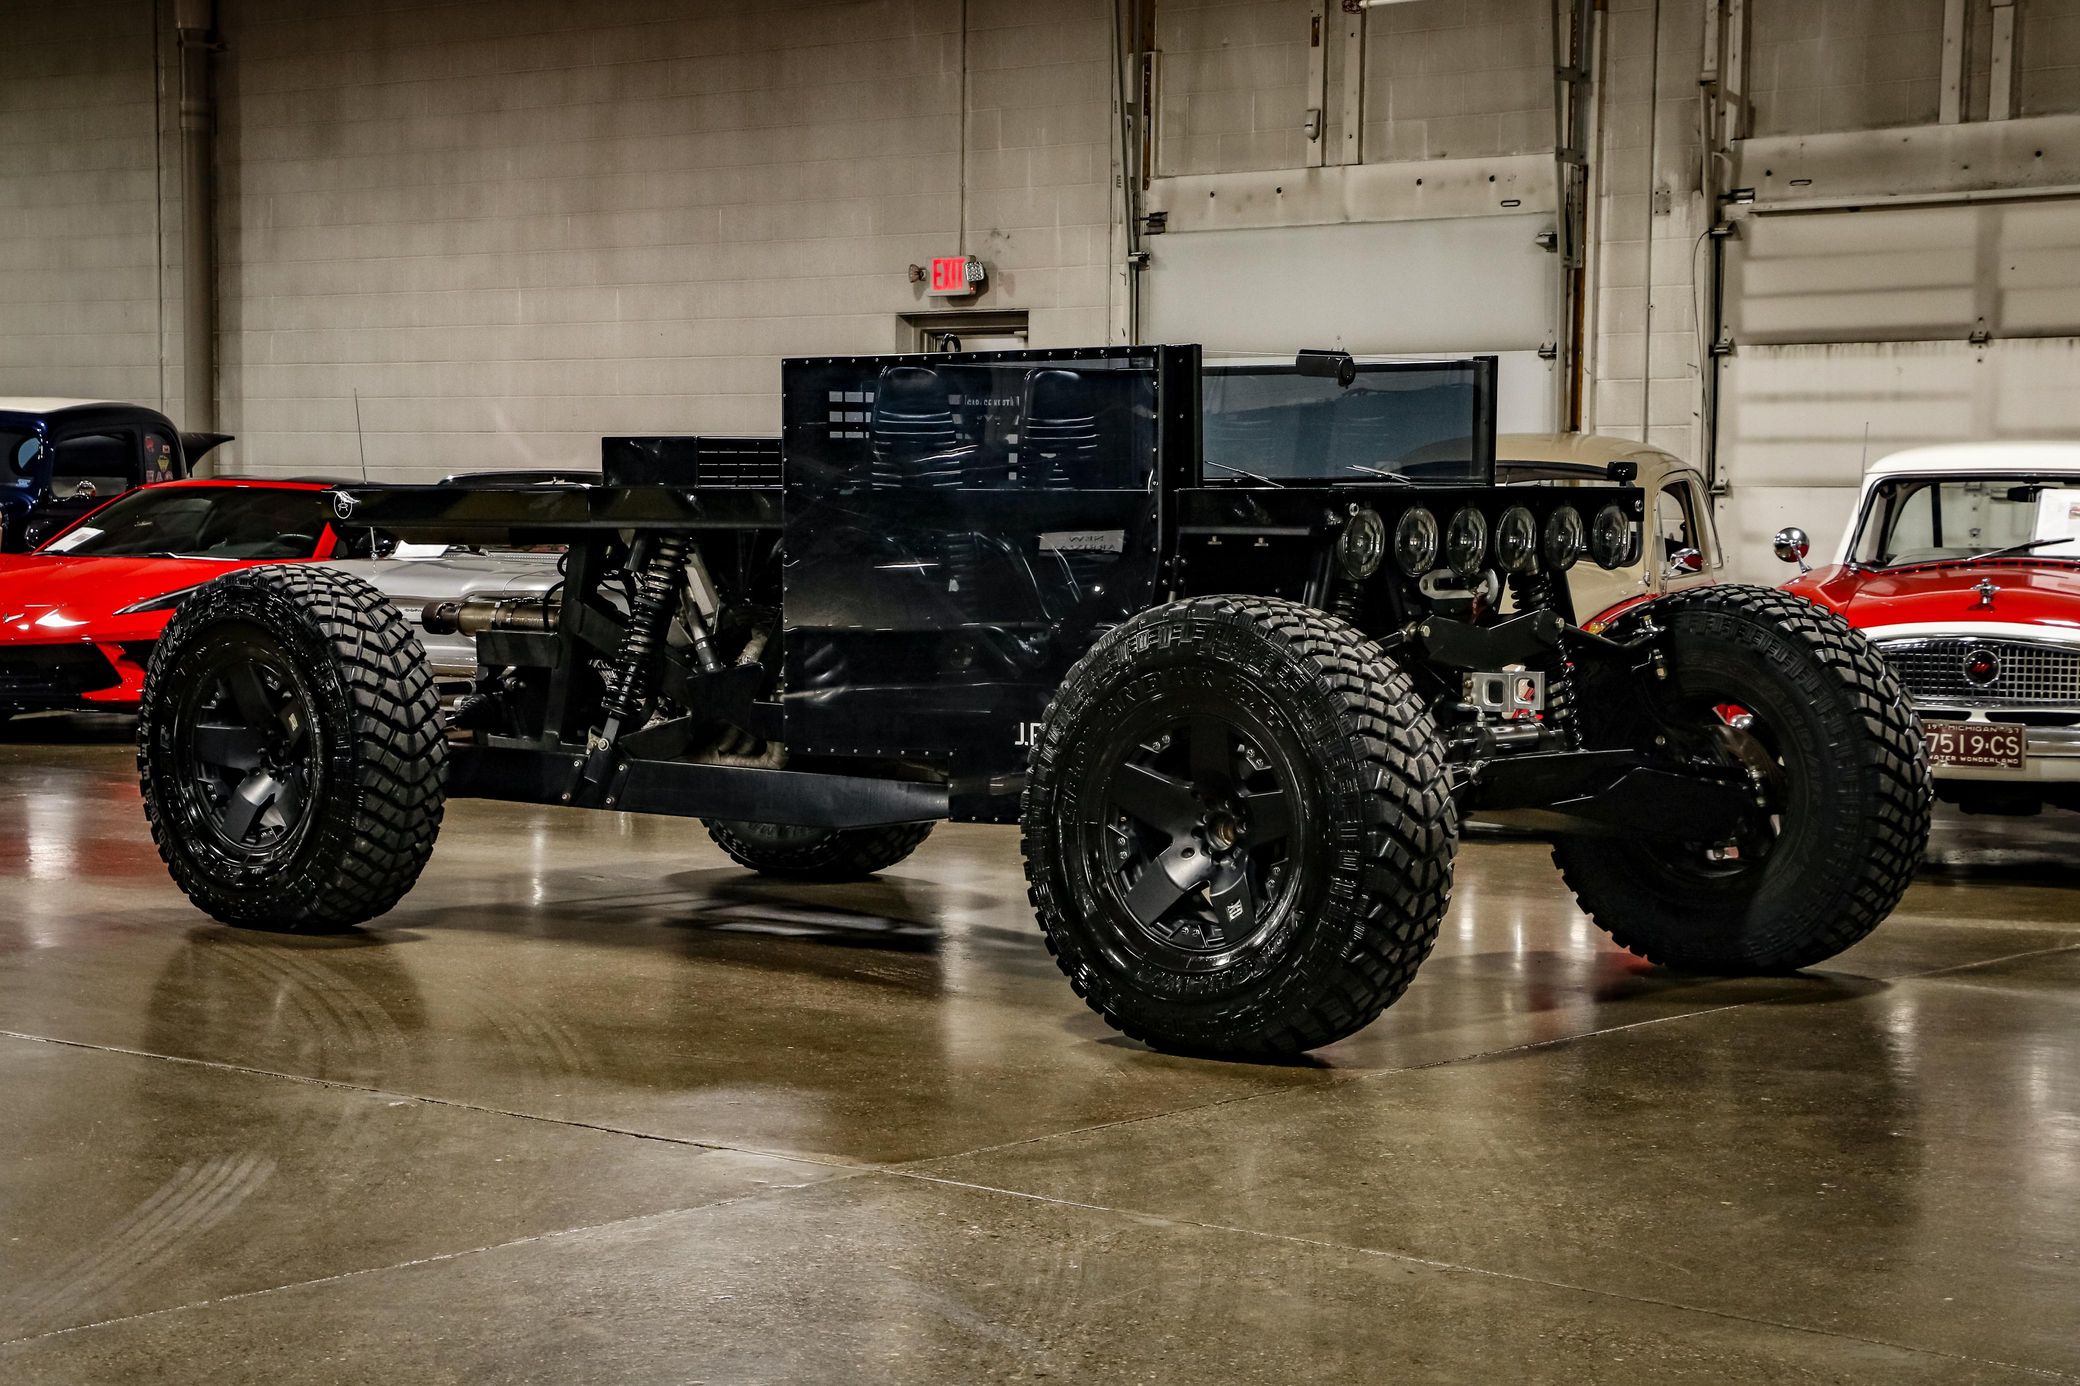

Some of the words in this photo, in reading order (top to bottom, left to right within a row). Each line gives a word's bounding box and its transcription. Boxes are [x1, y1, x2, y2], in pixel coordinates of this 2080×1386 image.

[932, 258, 966, 291] EXIT
[1948, 725, 1998, 733] MICHIGAN
[1960, 756, 2020, 765] WONDERLAND
